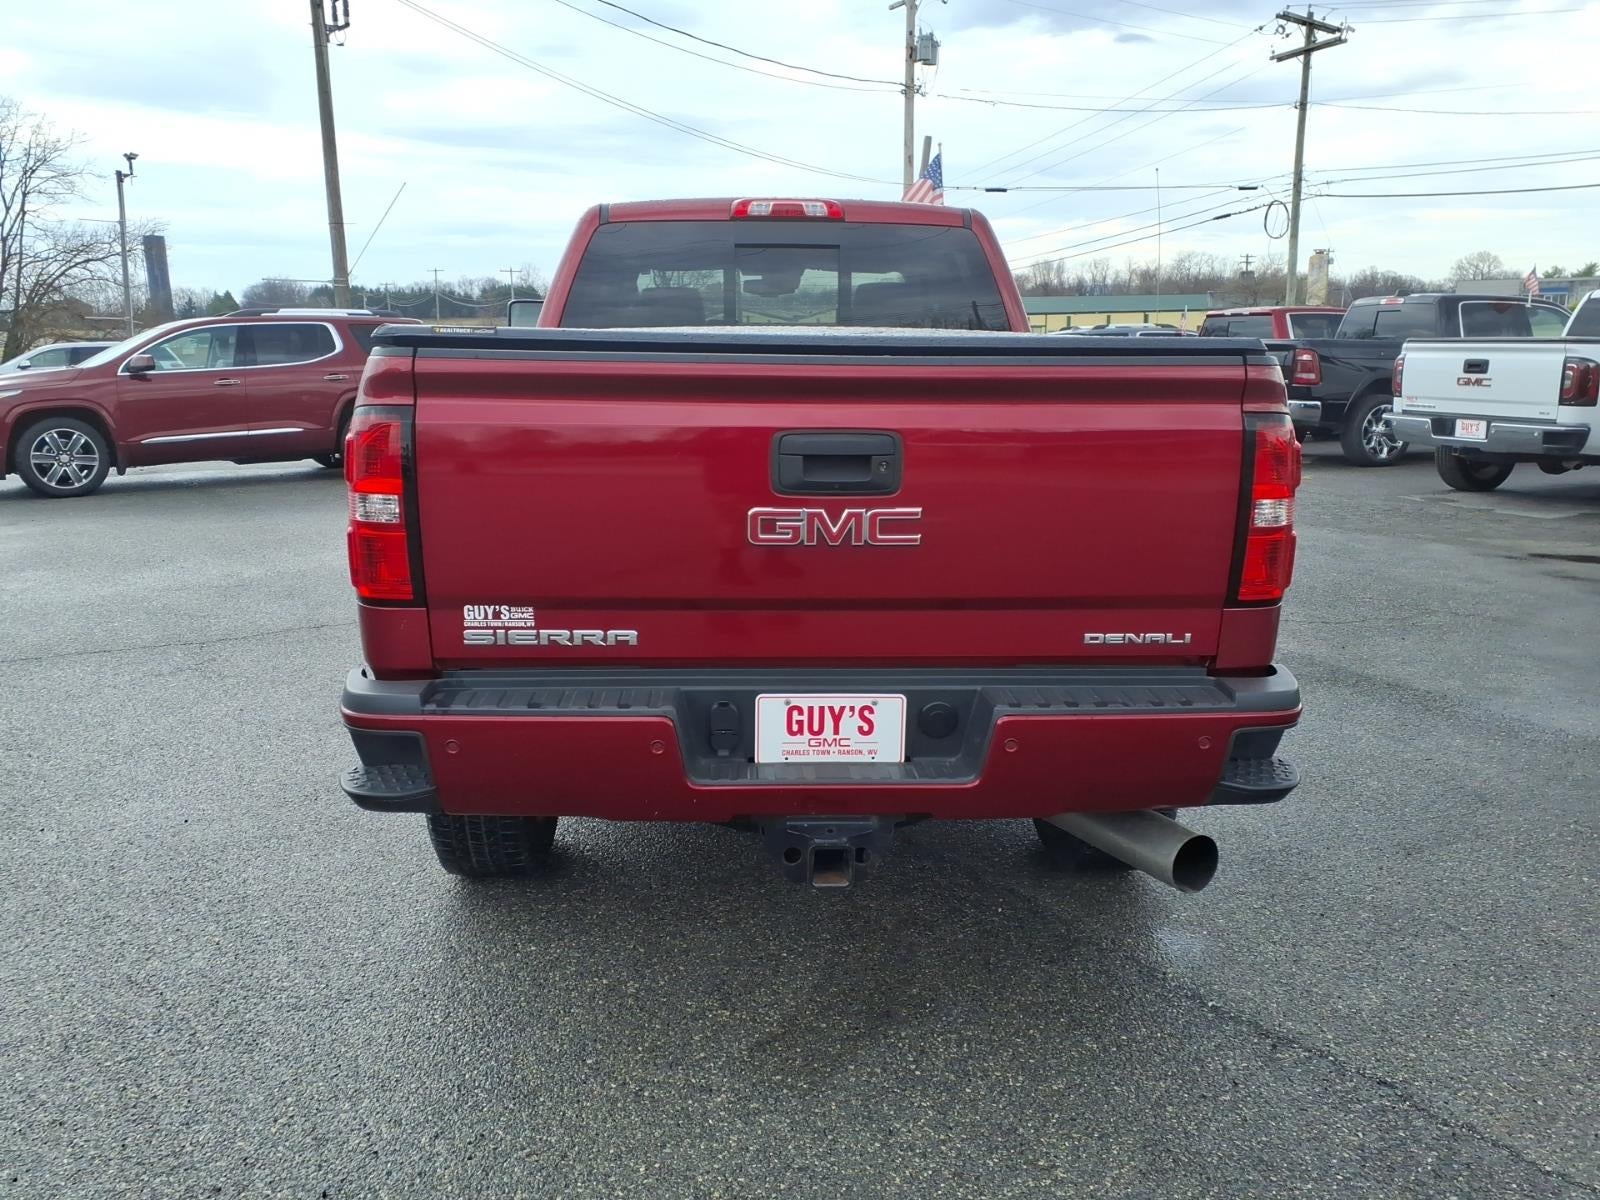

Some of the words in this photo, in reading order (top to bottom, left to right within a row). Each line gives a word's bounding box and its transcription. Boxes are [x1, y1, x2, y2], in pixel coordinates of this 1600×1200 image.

[1456, 377, 1492, 387] GMC
[747, 507, 922, 546] GMC
[463, 605, 510, 620] GUY'S
[463, 629, 638, 646] SIERRA
[1083, 632, 1192, 645] DENALI
[786, 704, 875, 737] GUY'S
[807, 737, 851, 748] GMC
[781, 749, 810, 757] CHARLES
